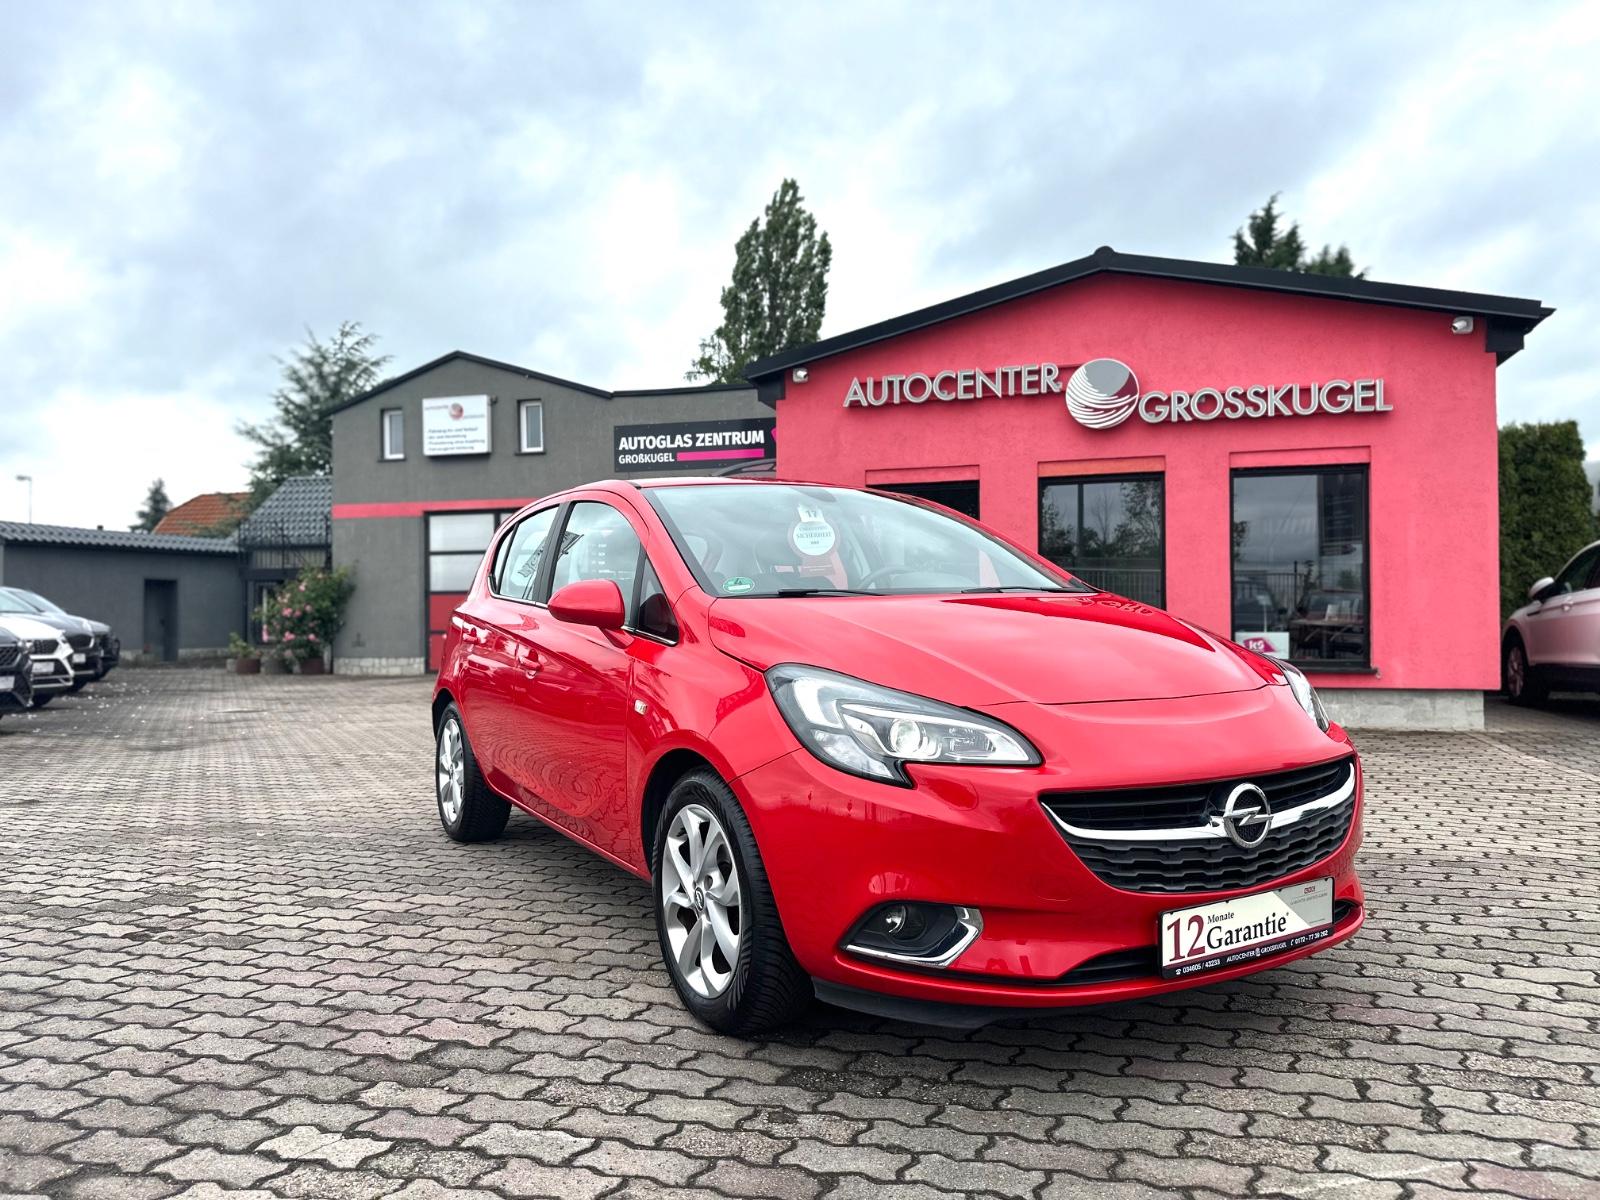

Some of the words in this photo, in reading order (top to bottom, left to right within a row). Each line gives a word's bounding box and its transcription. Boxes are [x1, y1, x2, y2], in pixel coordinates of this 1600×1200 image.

[843, 363, 1063, 408] AUTOCENTER
[1138, 377, 1394, 424] GROSSKUGEL
[618, 432, 693, 451] AUTOGLAS
[695, 429, 765, 447] ZENTRUM
[618, 452, 675, 464] GROßKUGEL
[1207, 912, 1235, 925] Monate
[1167, 914, 1206, 962] 12
